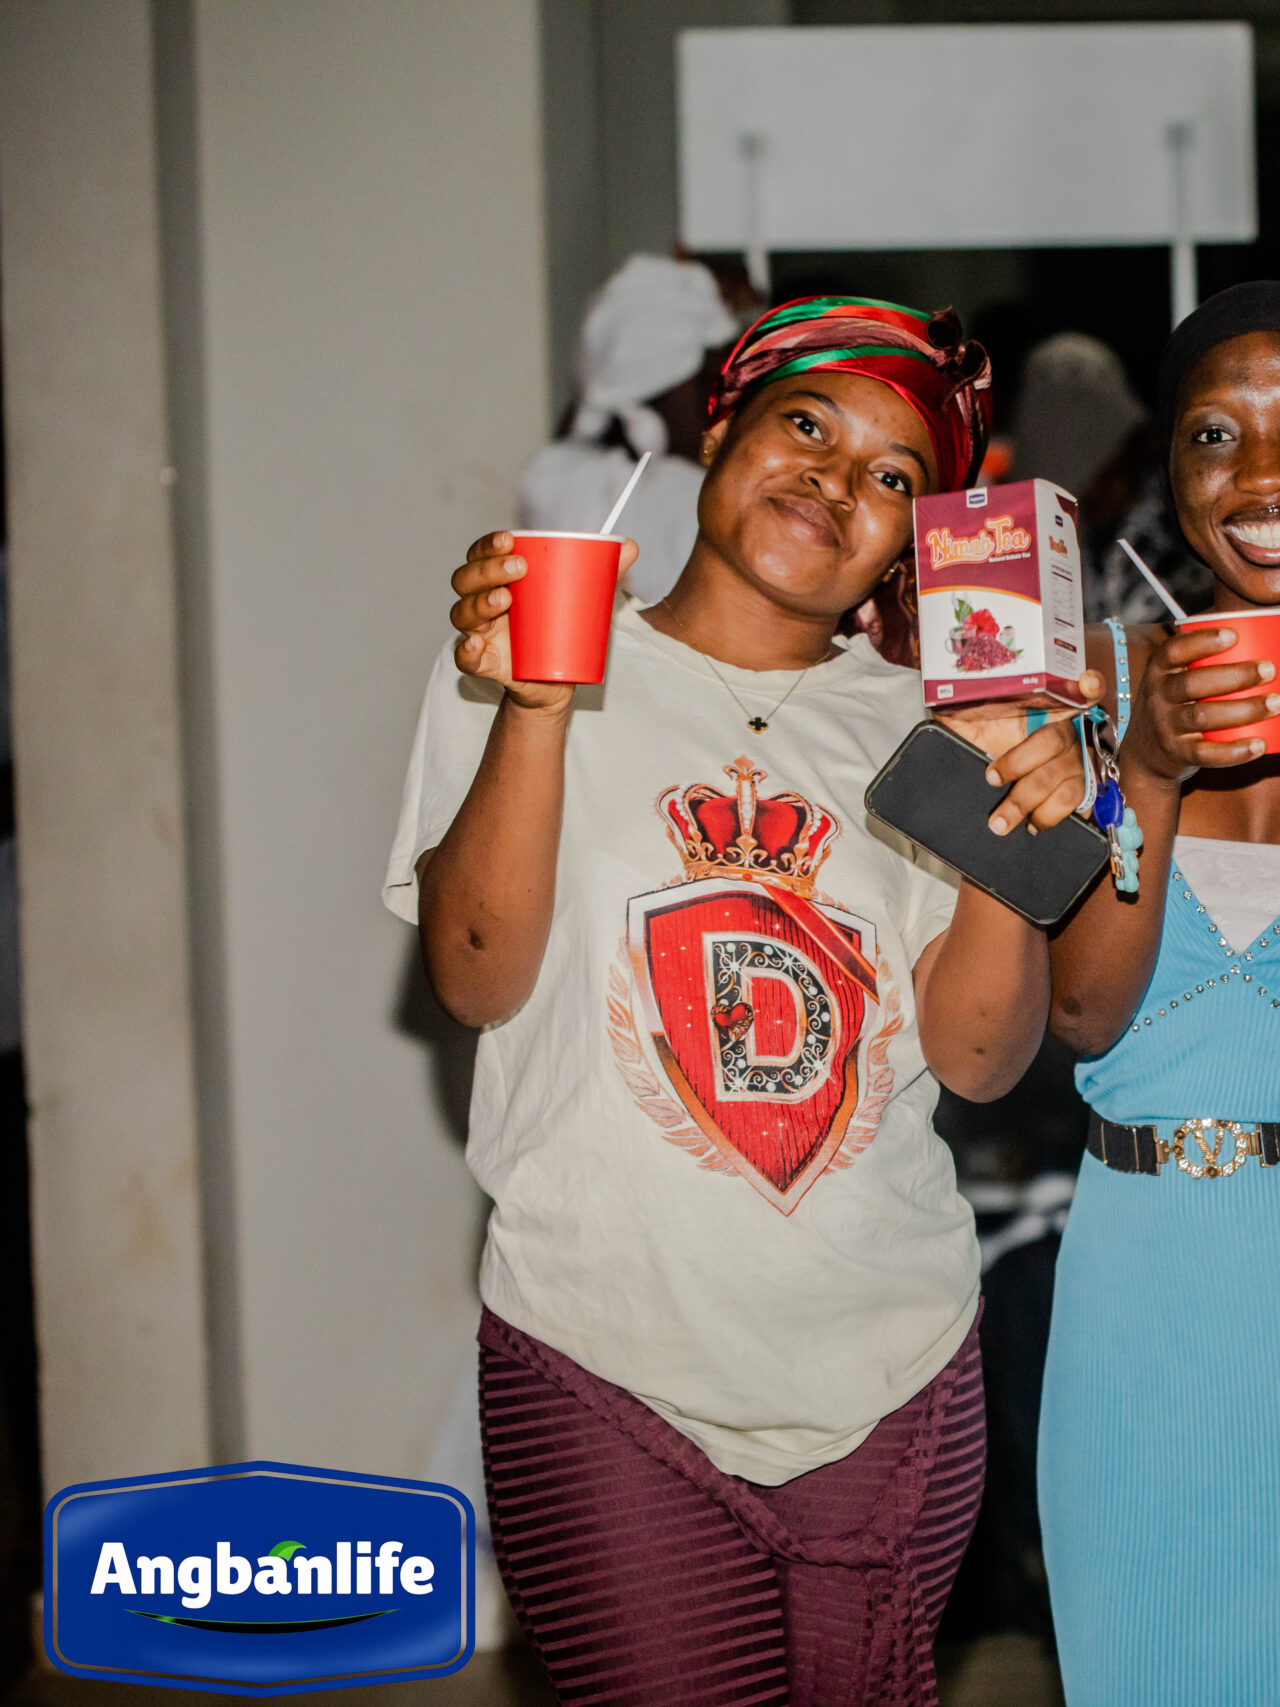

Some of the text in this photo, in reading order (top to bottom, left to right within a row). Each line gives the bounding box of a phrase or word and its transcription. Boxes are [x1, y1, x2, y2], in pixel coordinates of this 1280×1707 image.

[926, 527, 995, 569] Nimah
[984, 514, 1031, 556] Tea
[702, 931, 841, 1104] D
